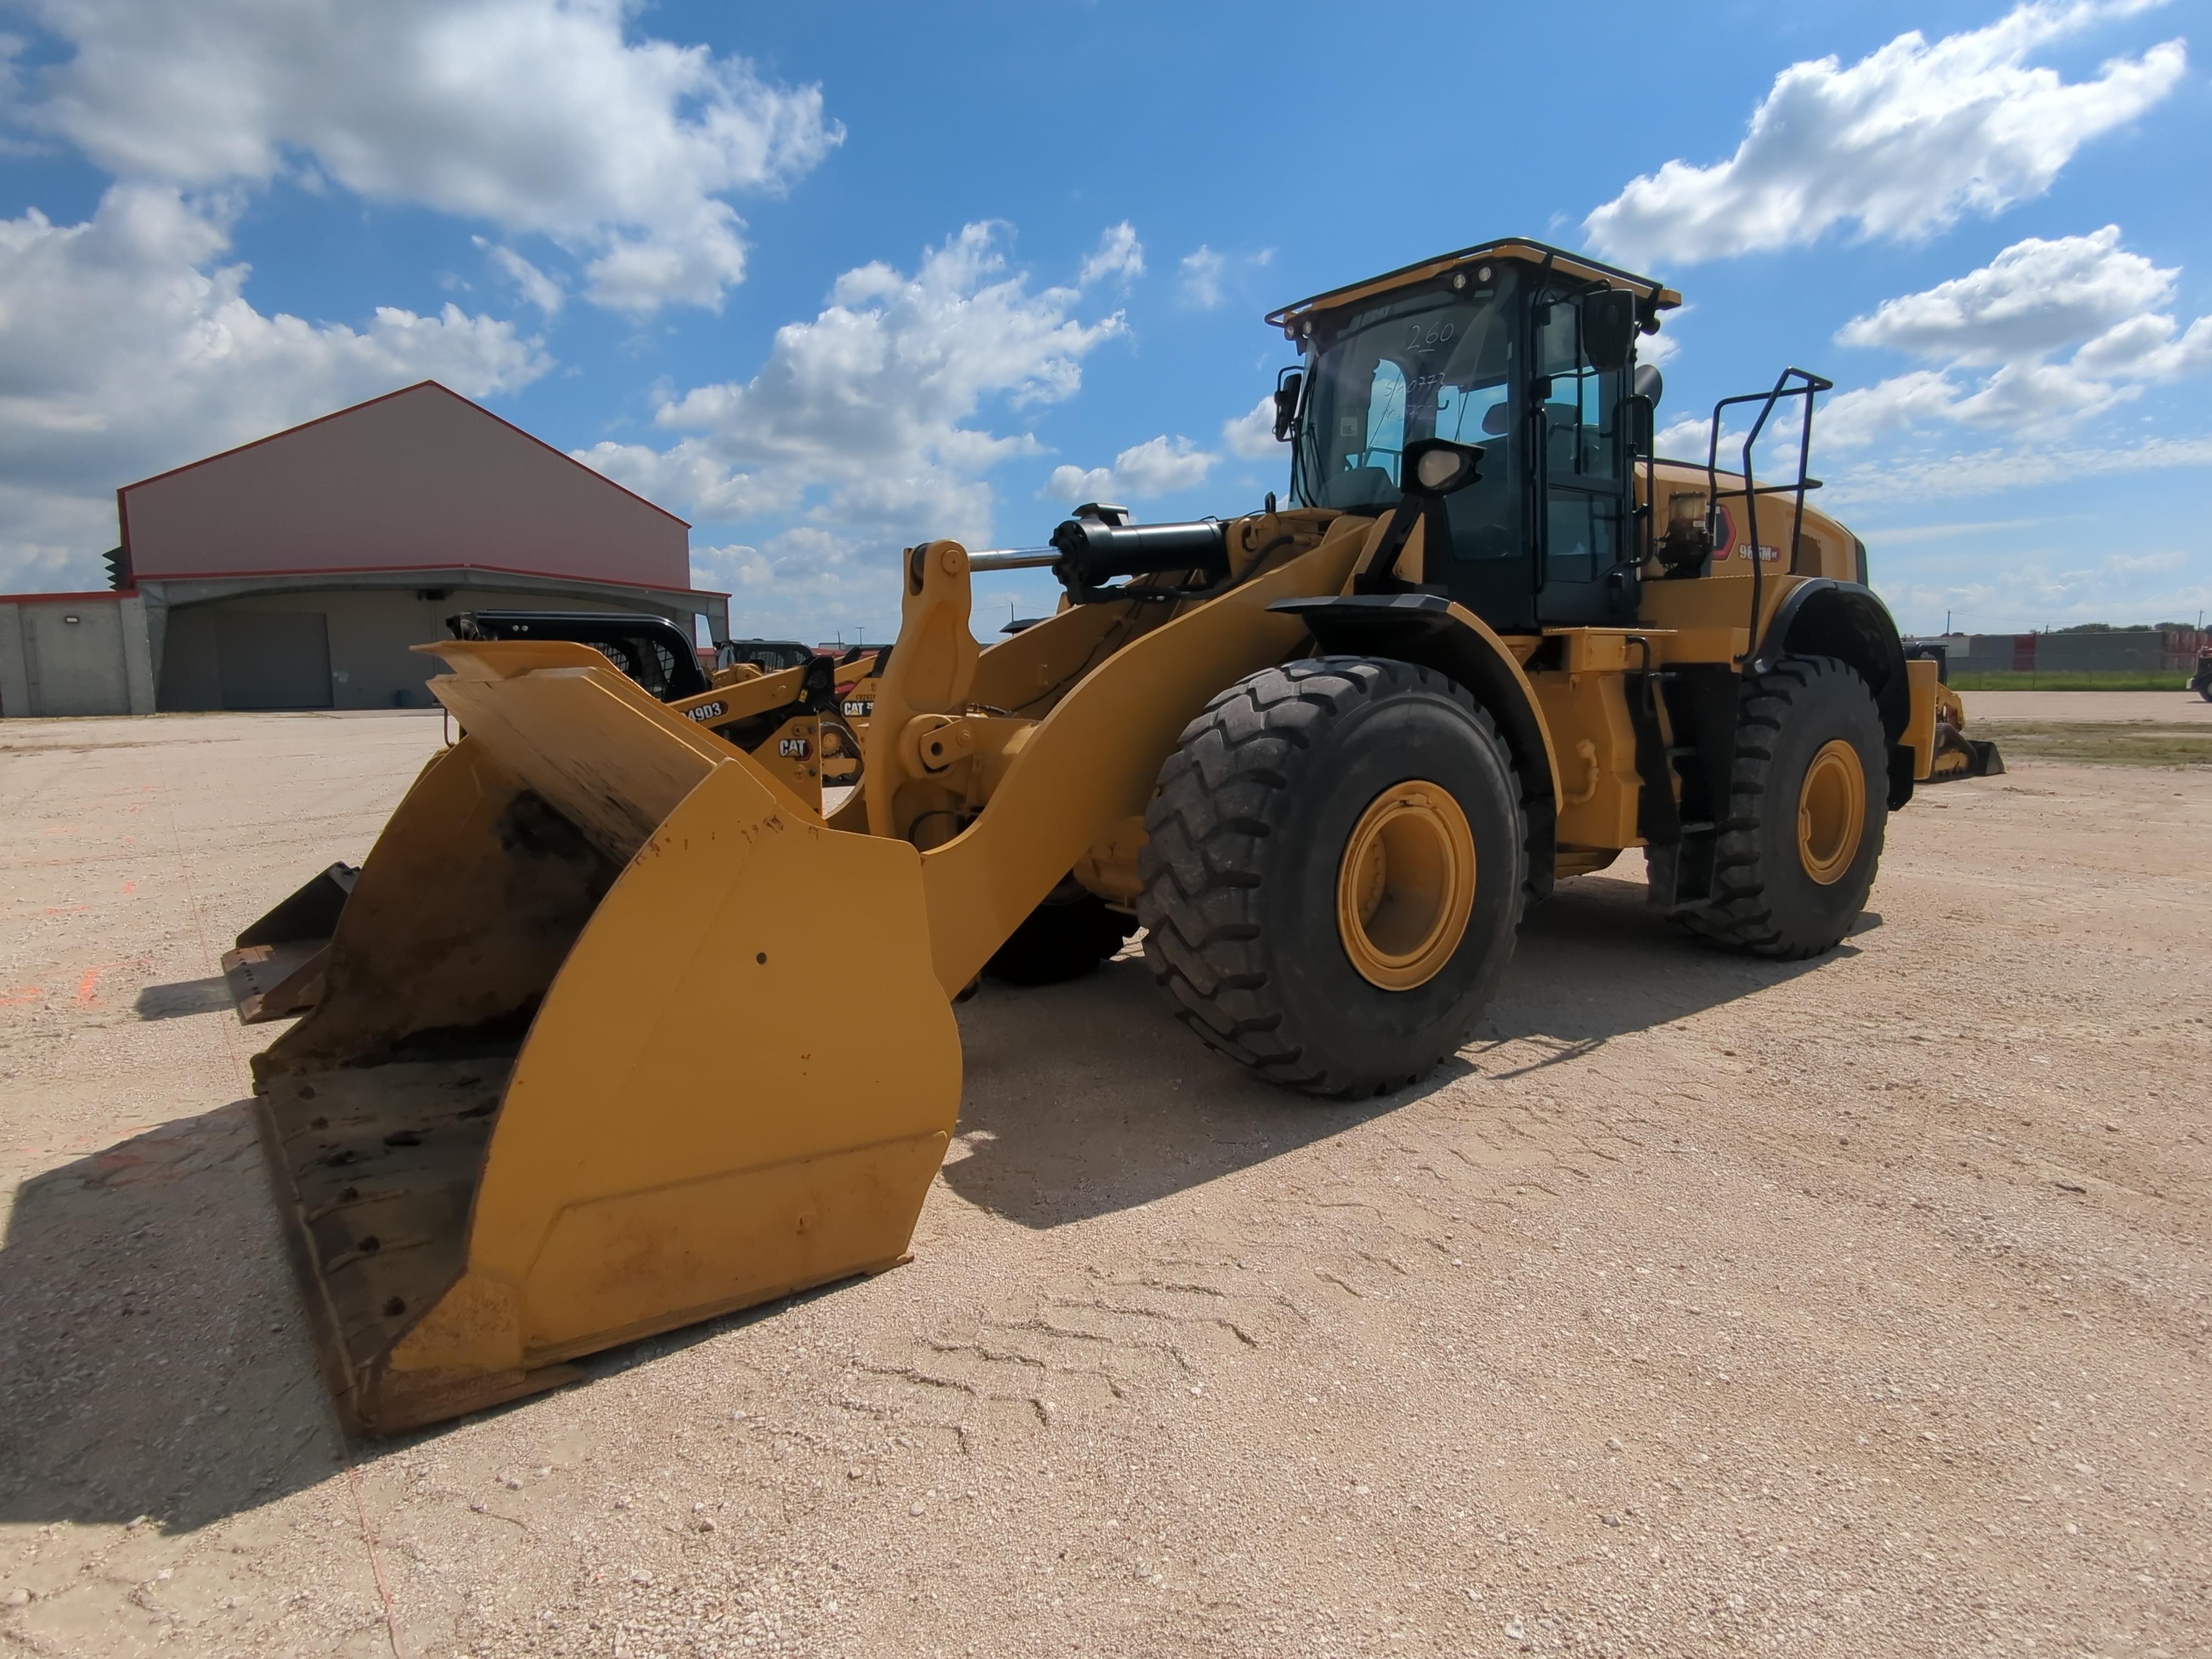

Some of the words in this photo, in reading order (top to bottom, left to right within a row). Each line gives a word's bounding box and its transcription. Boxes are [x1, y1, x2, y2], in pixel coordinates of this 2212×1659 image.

[1407, 321, 1454, 350] 260
[681, 702, 722, 721] 49D3
[844, 702, 864, 716] CAT
[780, 739, 805, 757] CAT
